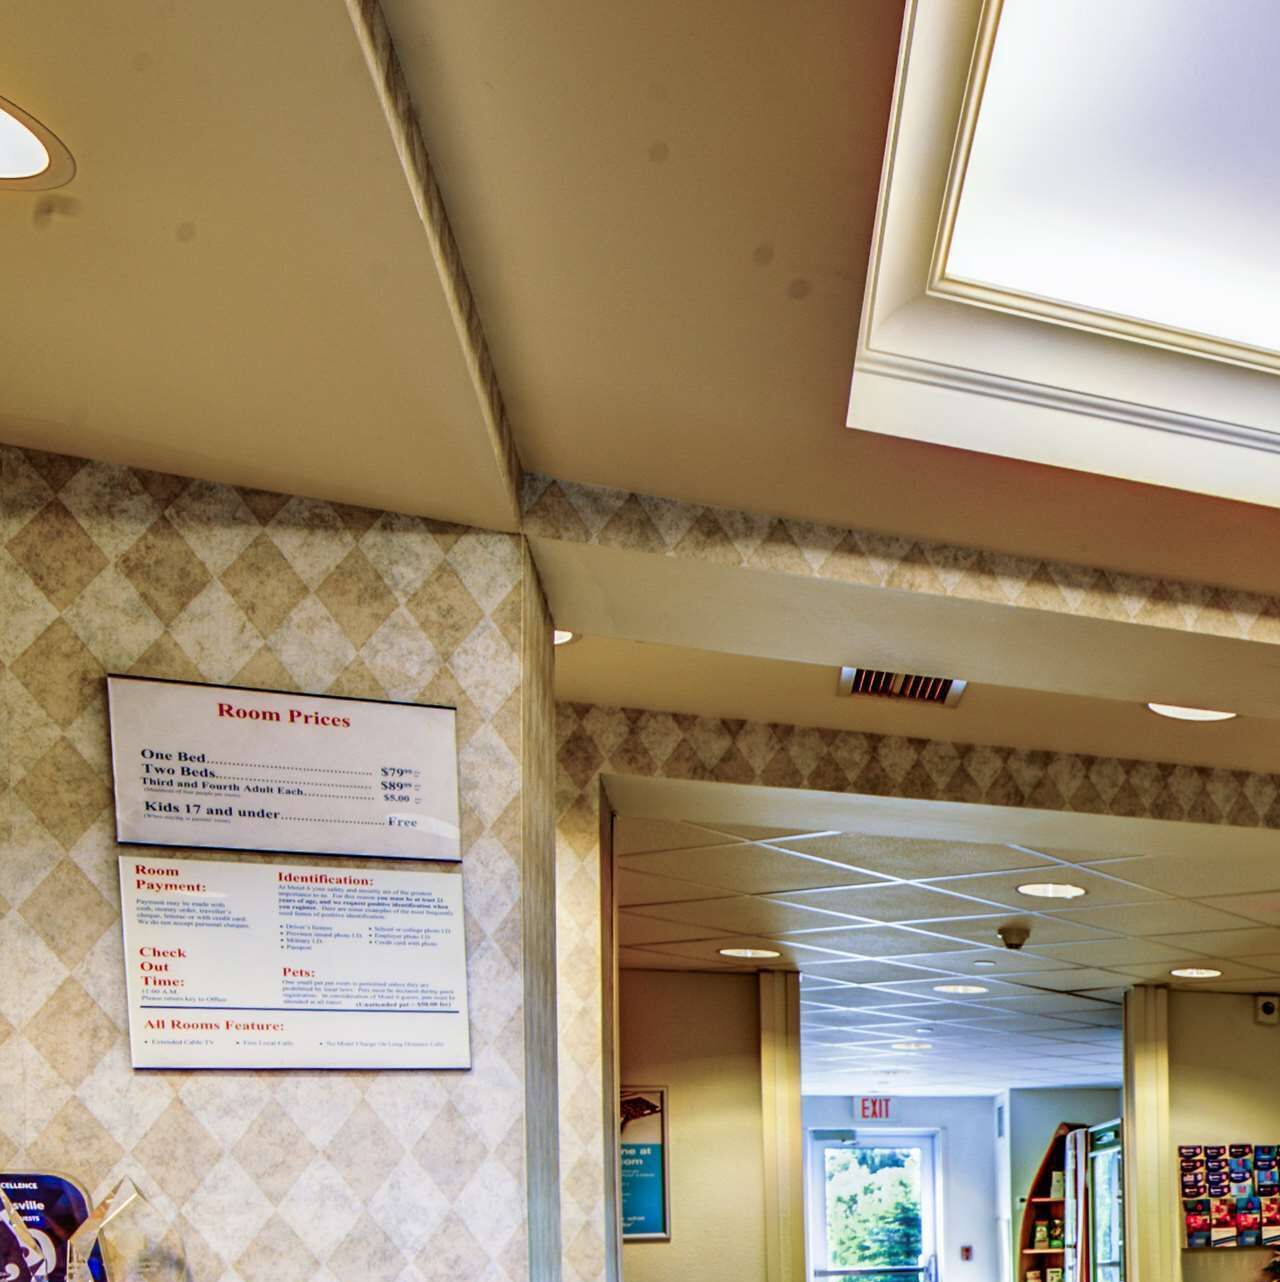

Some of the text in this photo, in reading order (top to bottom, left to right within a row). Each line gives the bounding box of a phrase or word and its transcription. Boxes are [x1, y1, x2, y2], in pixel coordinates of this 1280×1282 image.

[217, 702, 351, 728] Room Prices
[141, 749, 173, 761] One
[141, 763, 176, 776] Two
[140, 777, 174, 788] Third
[177, 780, 198, 789] and
[202, 780, 241, 792] Fourth
[243, 783, 274, 795] Adult
[144, 801, 180, 813] Kids
[184, 804, 201, 814] 17
[206, 806, 233, 817] and
[237, 808, 281, 820] under
[387, 816, 418, 828] Free
[135, 864, 180, 877] Room
[136, 879, 207, 893] Payment:
[278, 872, 373, 887] Identification:
[139, 946, 187, 958] Check
[140, 961, 169, 972] Out
[282, 967, 316, 978] Pets:
[140, 975, 185, 987] Time:
[144, 1019, 284, 1032] All Rooms Feature:
[861, 1097, 891, 1119] EXIT
[639, 1147, 651, 1156] at
[12, 1200, 46, 1211] sville
